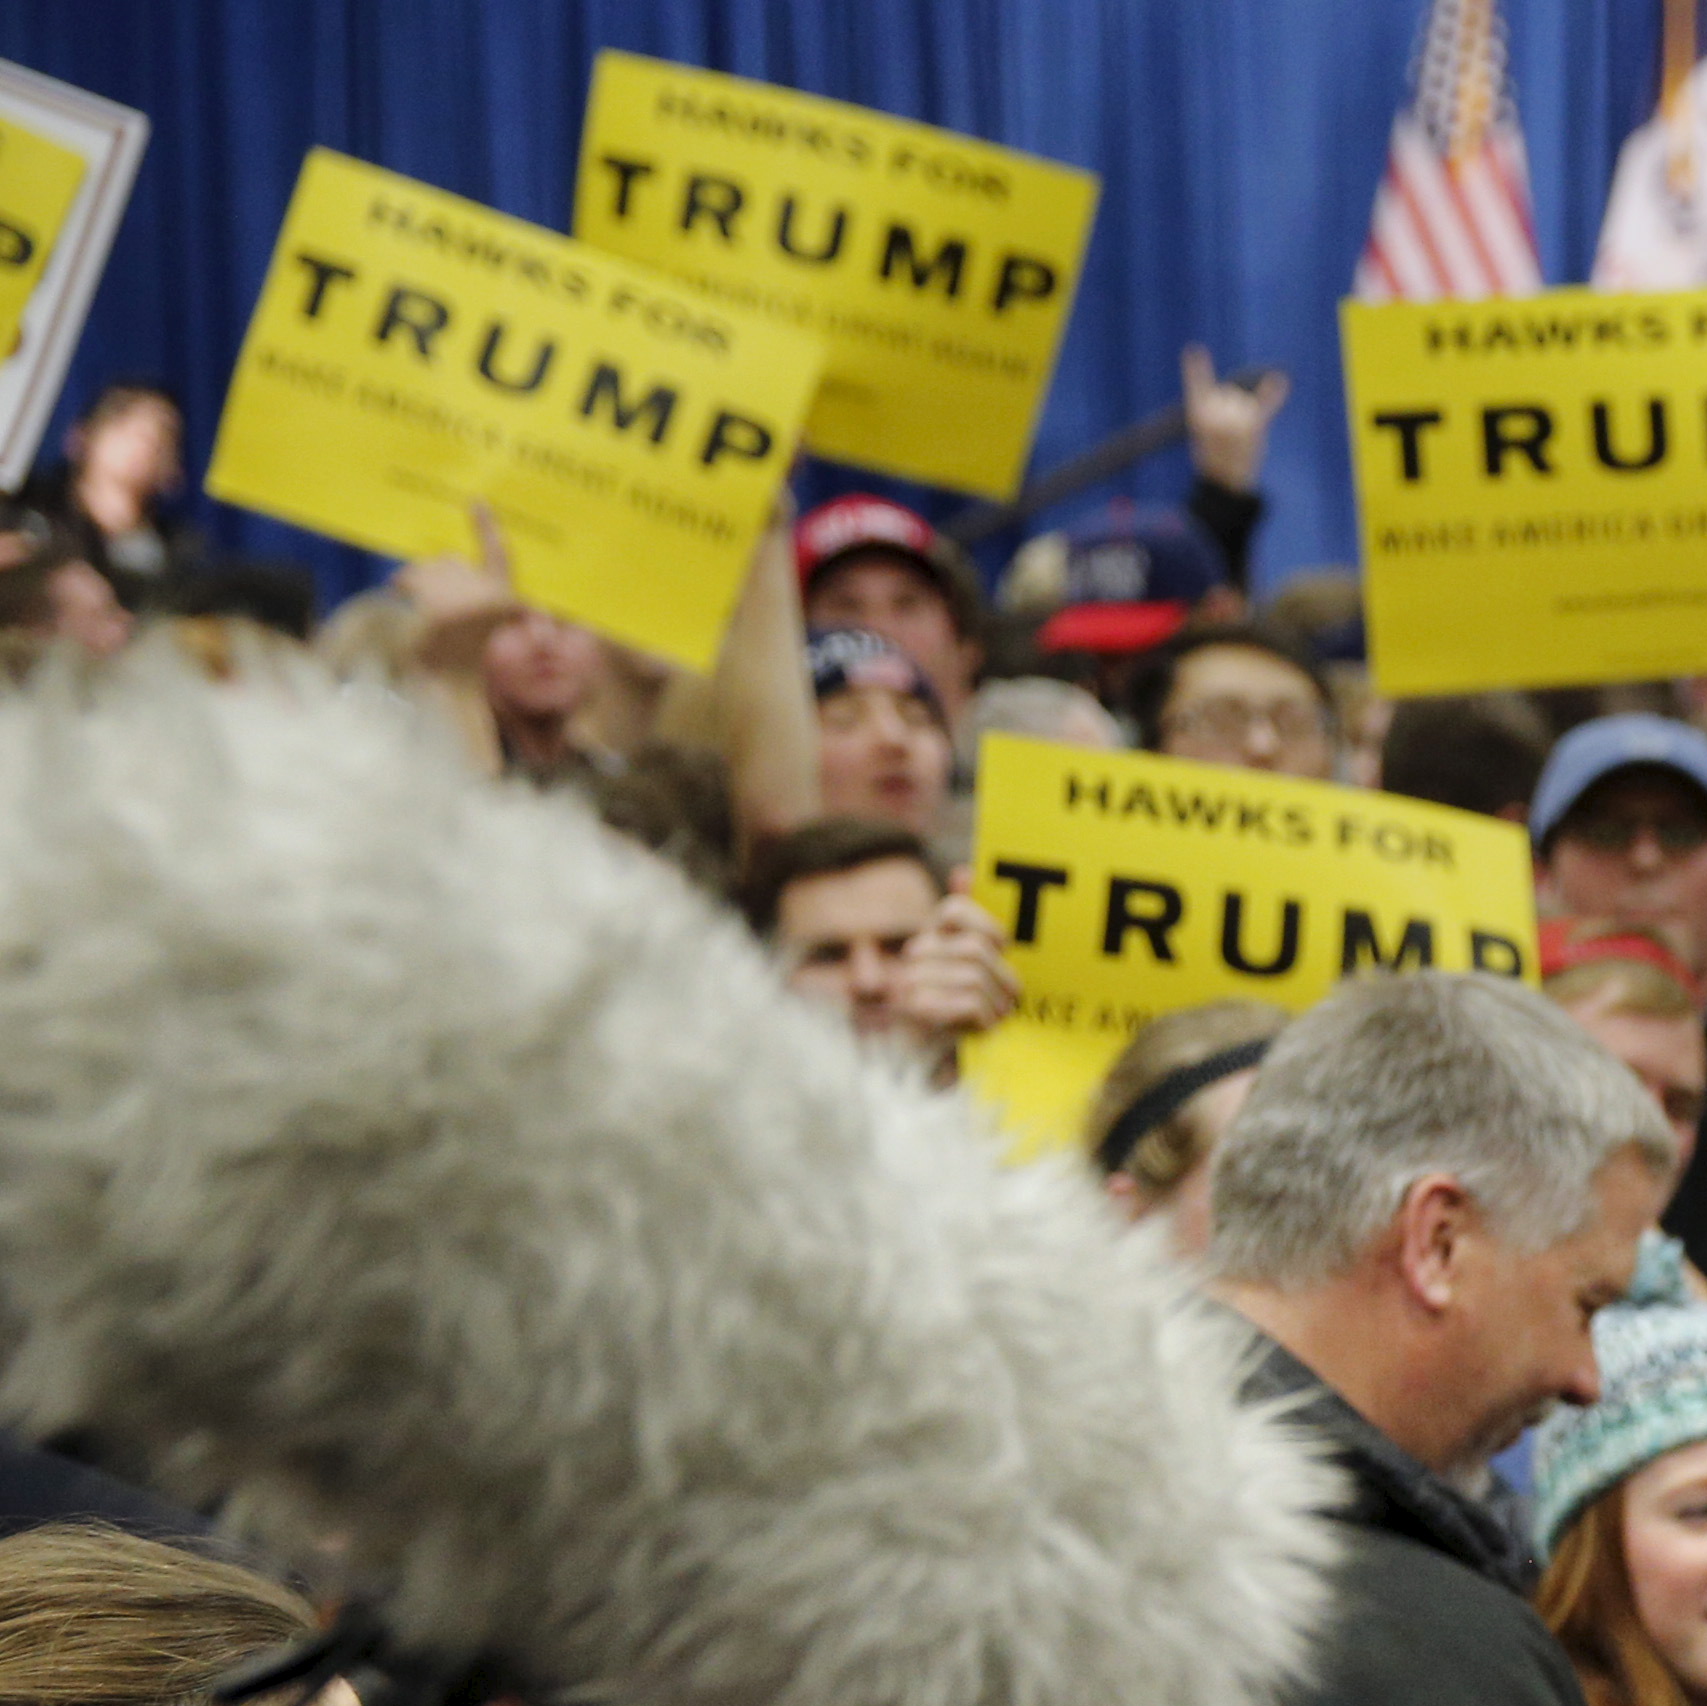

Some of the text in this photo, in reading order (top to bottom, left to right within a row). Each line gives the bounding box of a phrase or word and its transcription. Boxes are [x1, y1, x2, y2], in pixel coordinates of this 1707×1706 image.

[602, 157, 1059, 318] TRUMP
[299, 255, 774, 468] TRUMP
[1425, 312, 1666, 356] HAWKS
[1065, 774, 1454, 868] HAWKS FOR
